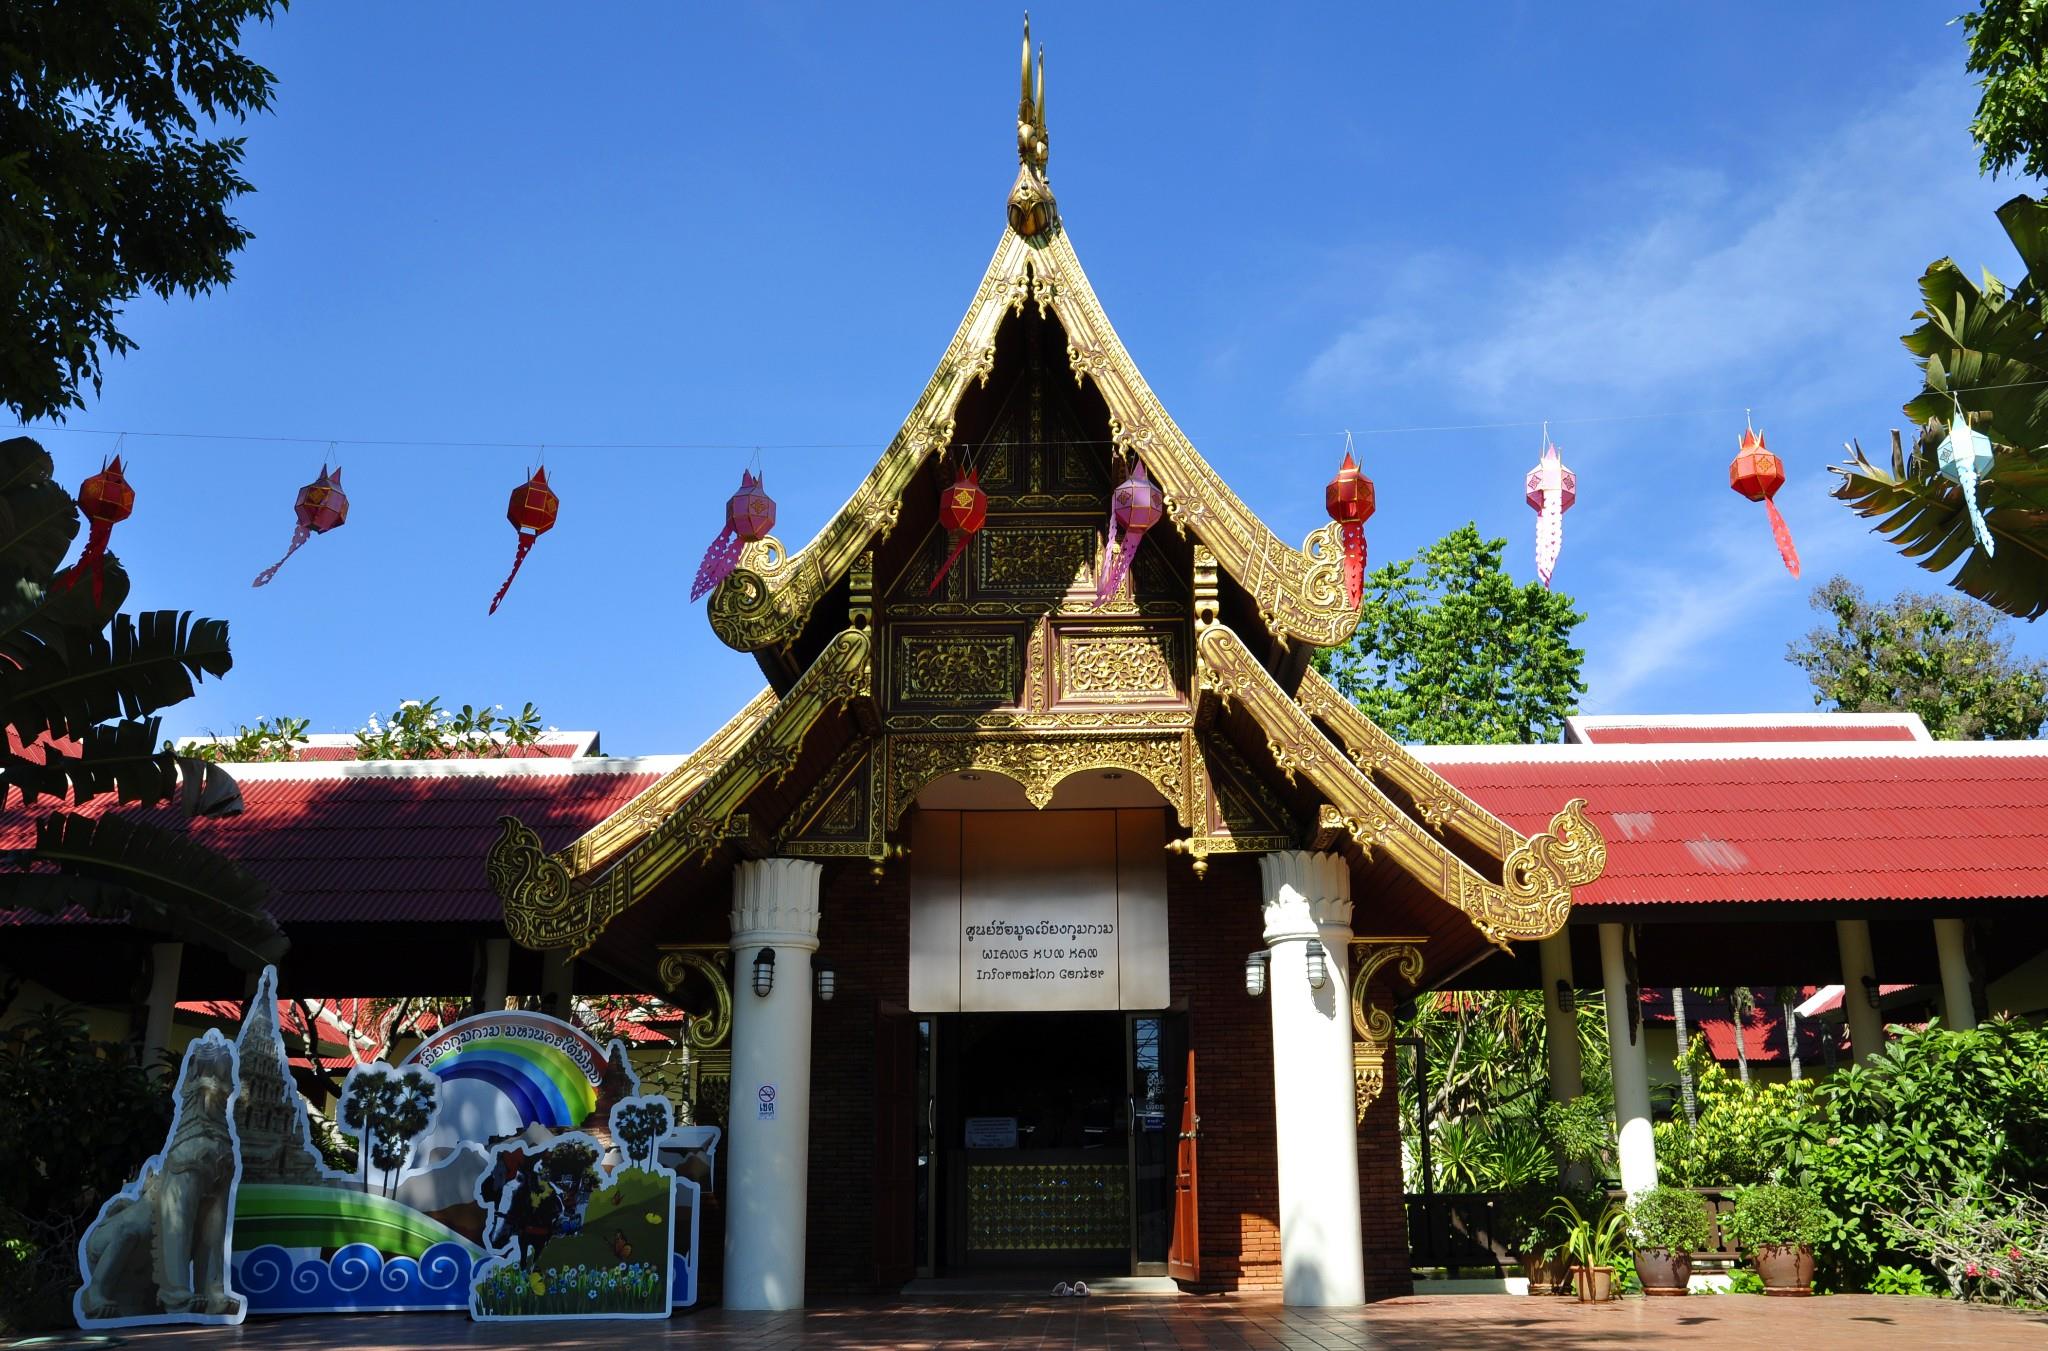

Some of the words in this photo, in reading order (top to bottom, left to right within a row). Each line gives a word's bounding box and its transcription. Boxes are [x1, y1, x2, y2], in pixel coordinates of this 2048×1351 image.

[965, 920, 1114, 941] ศูนย์ข้อมูลเวียงกุมกาม
[982, 949, 1029, 960] WIANG
[976, 967, 1055, 980] Information
[1059, 967, 1105, 980] Center
